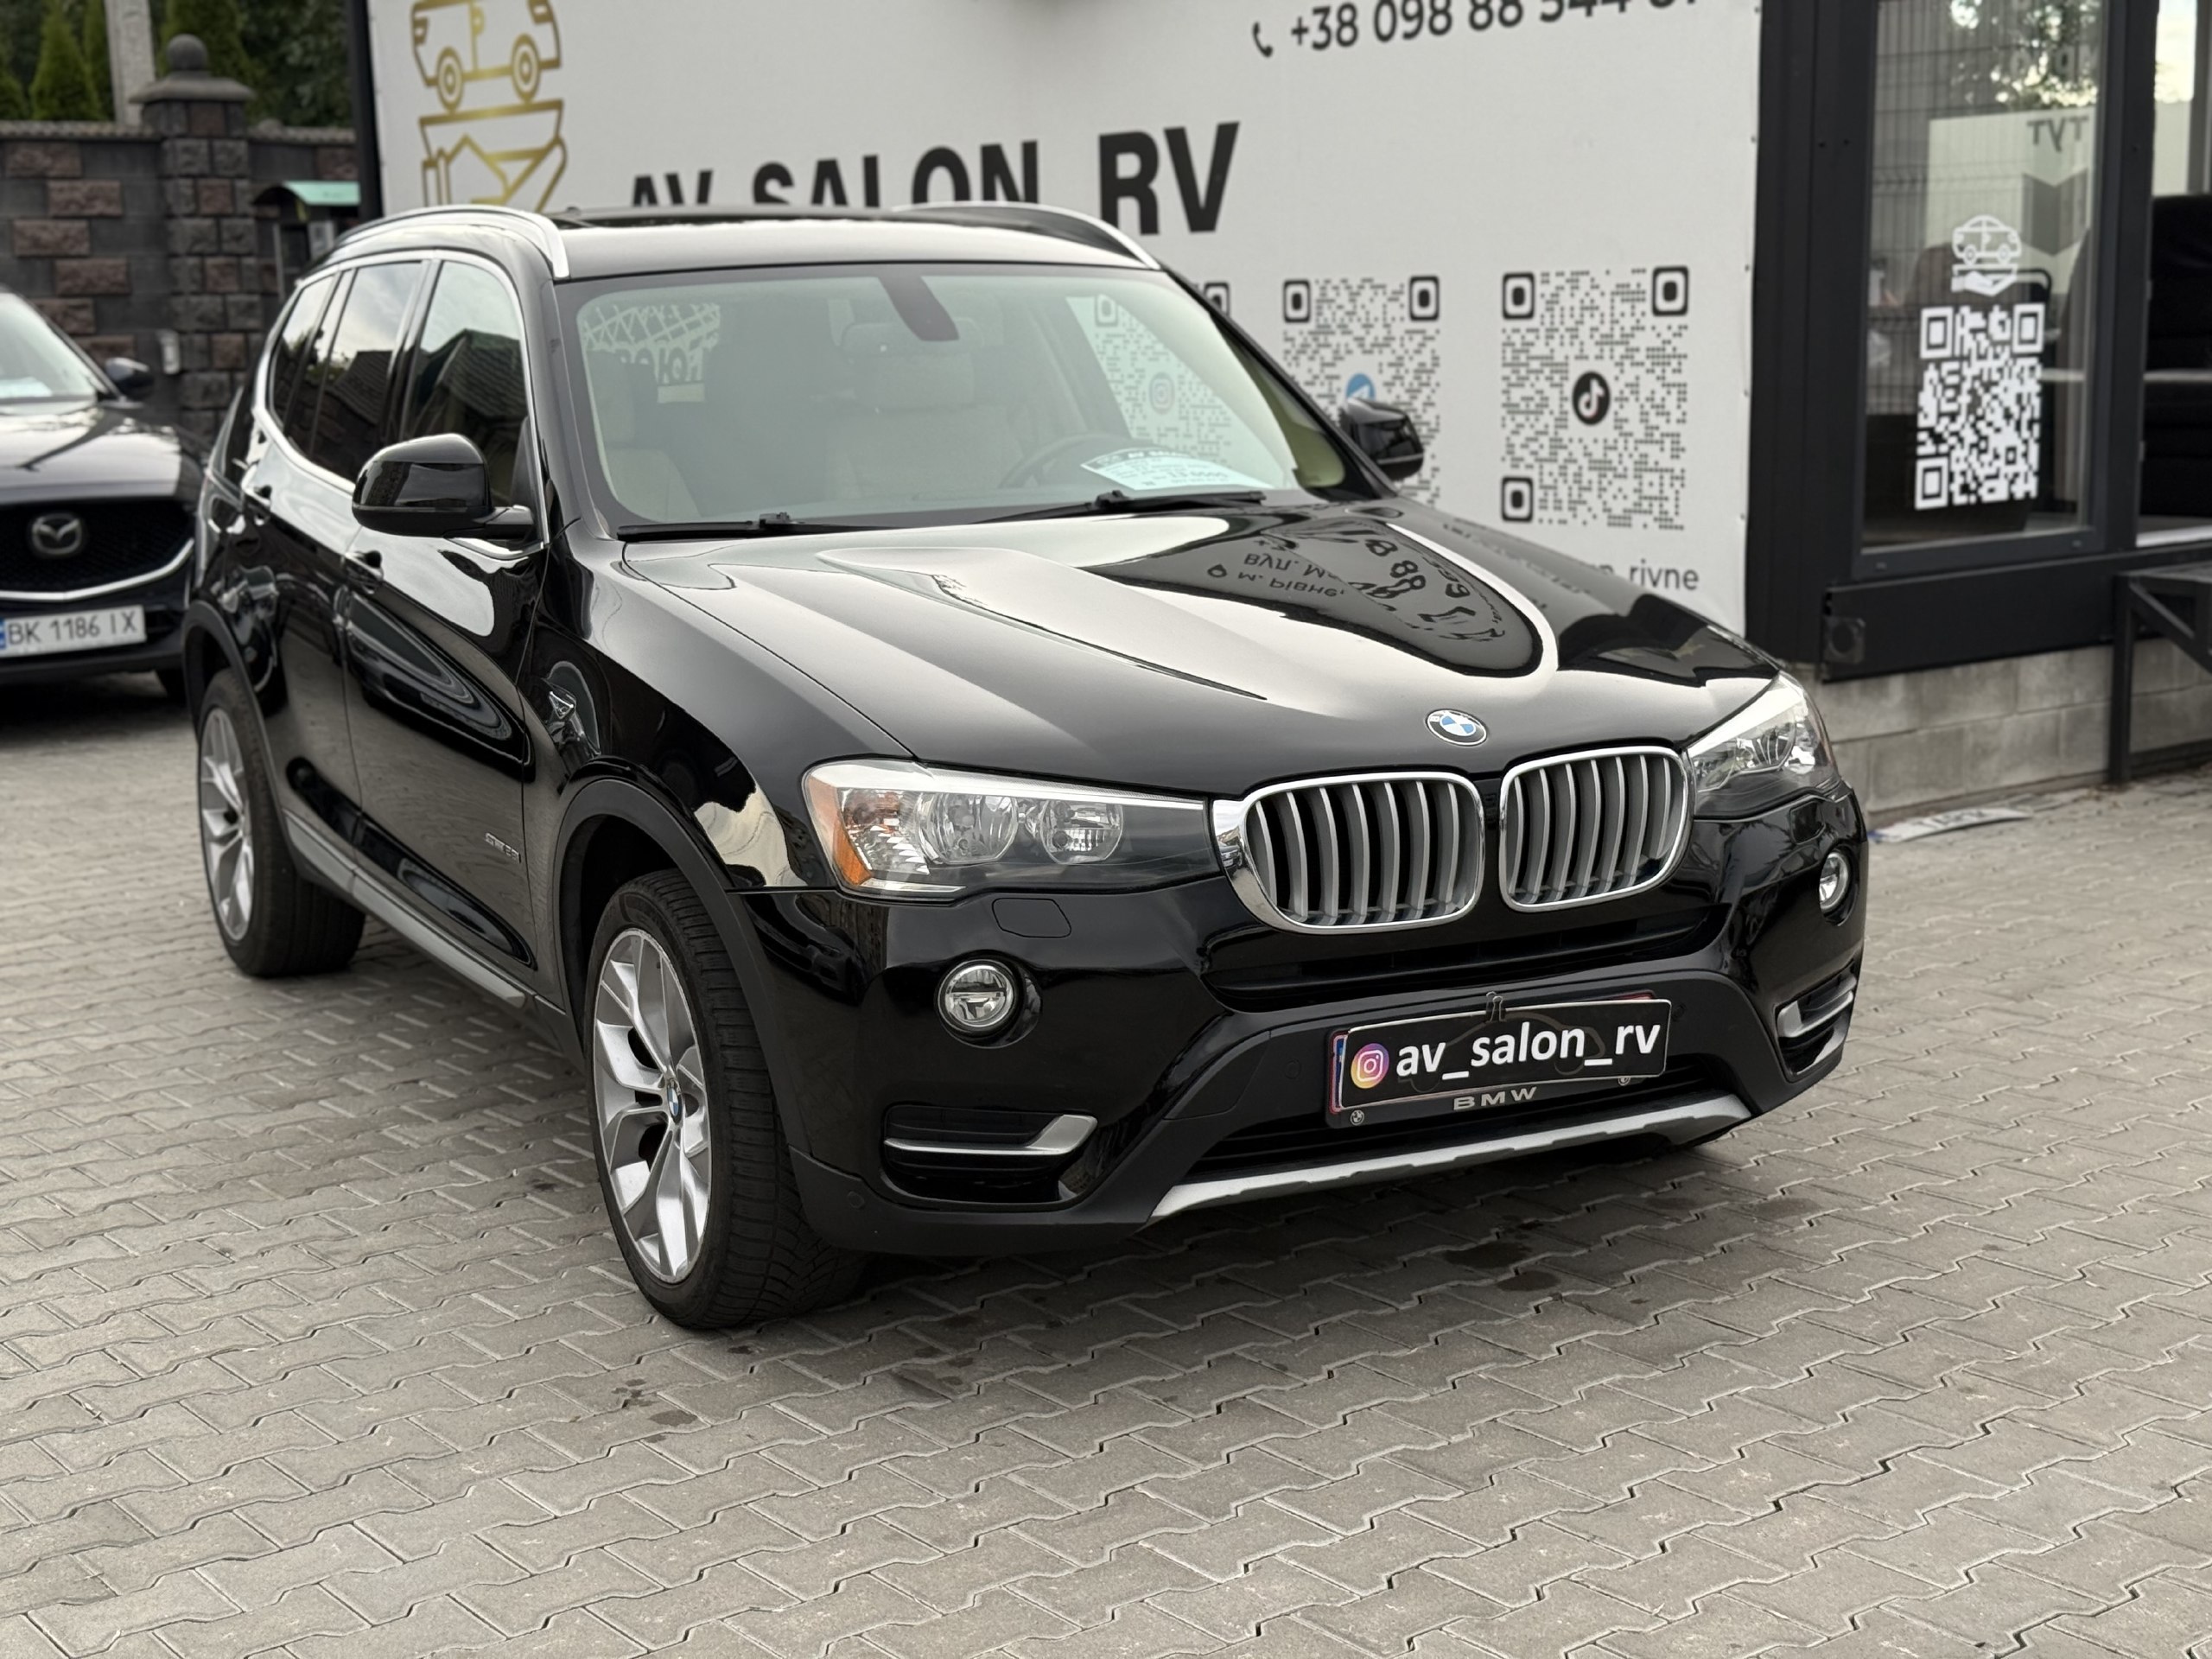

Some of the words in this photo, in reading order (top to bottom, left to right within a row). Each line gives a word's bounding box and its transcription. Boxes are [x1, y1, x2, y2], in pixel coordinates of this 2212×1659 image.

[1291, 3, 1358, 50] +38
[1373, 0, 1452, 42] 098
[1098, 121, 1240, 236] RV
[8, 620, 41, 645] BK
[49, 615, 101, 641] 1186
[1395, 1021, 1661, 1081] av_salon_rv
[1452, 1086, 1537, 1111] BMW
